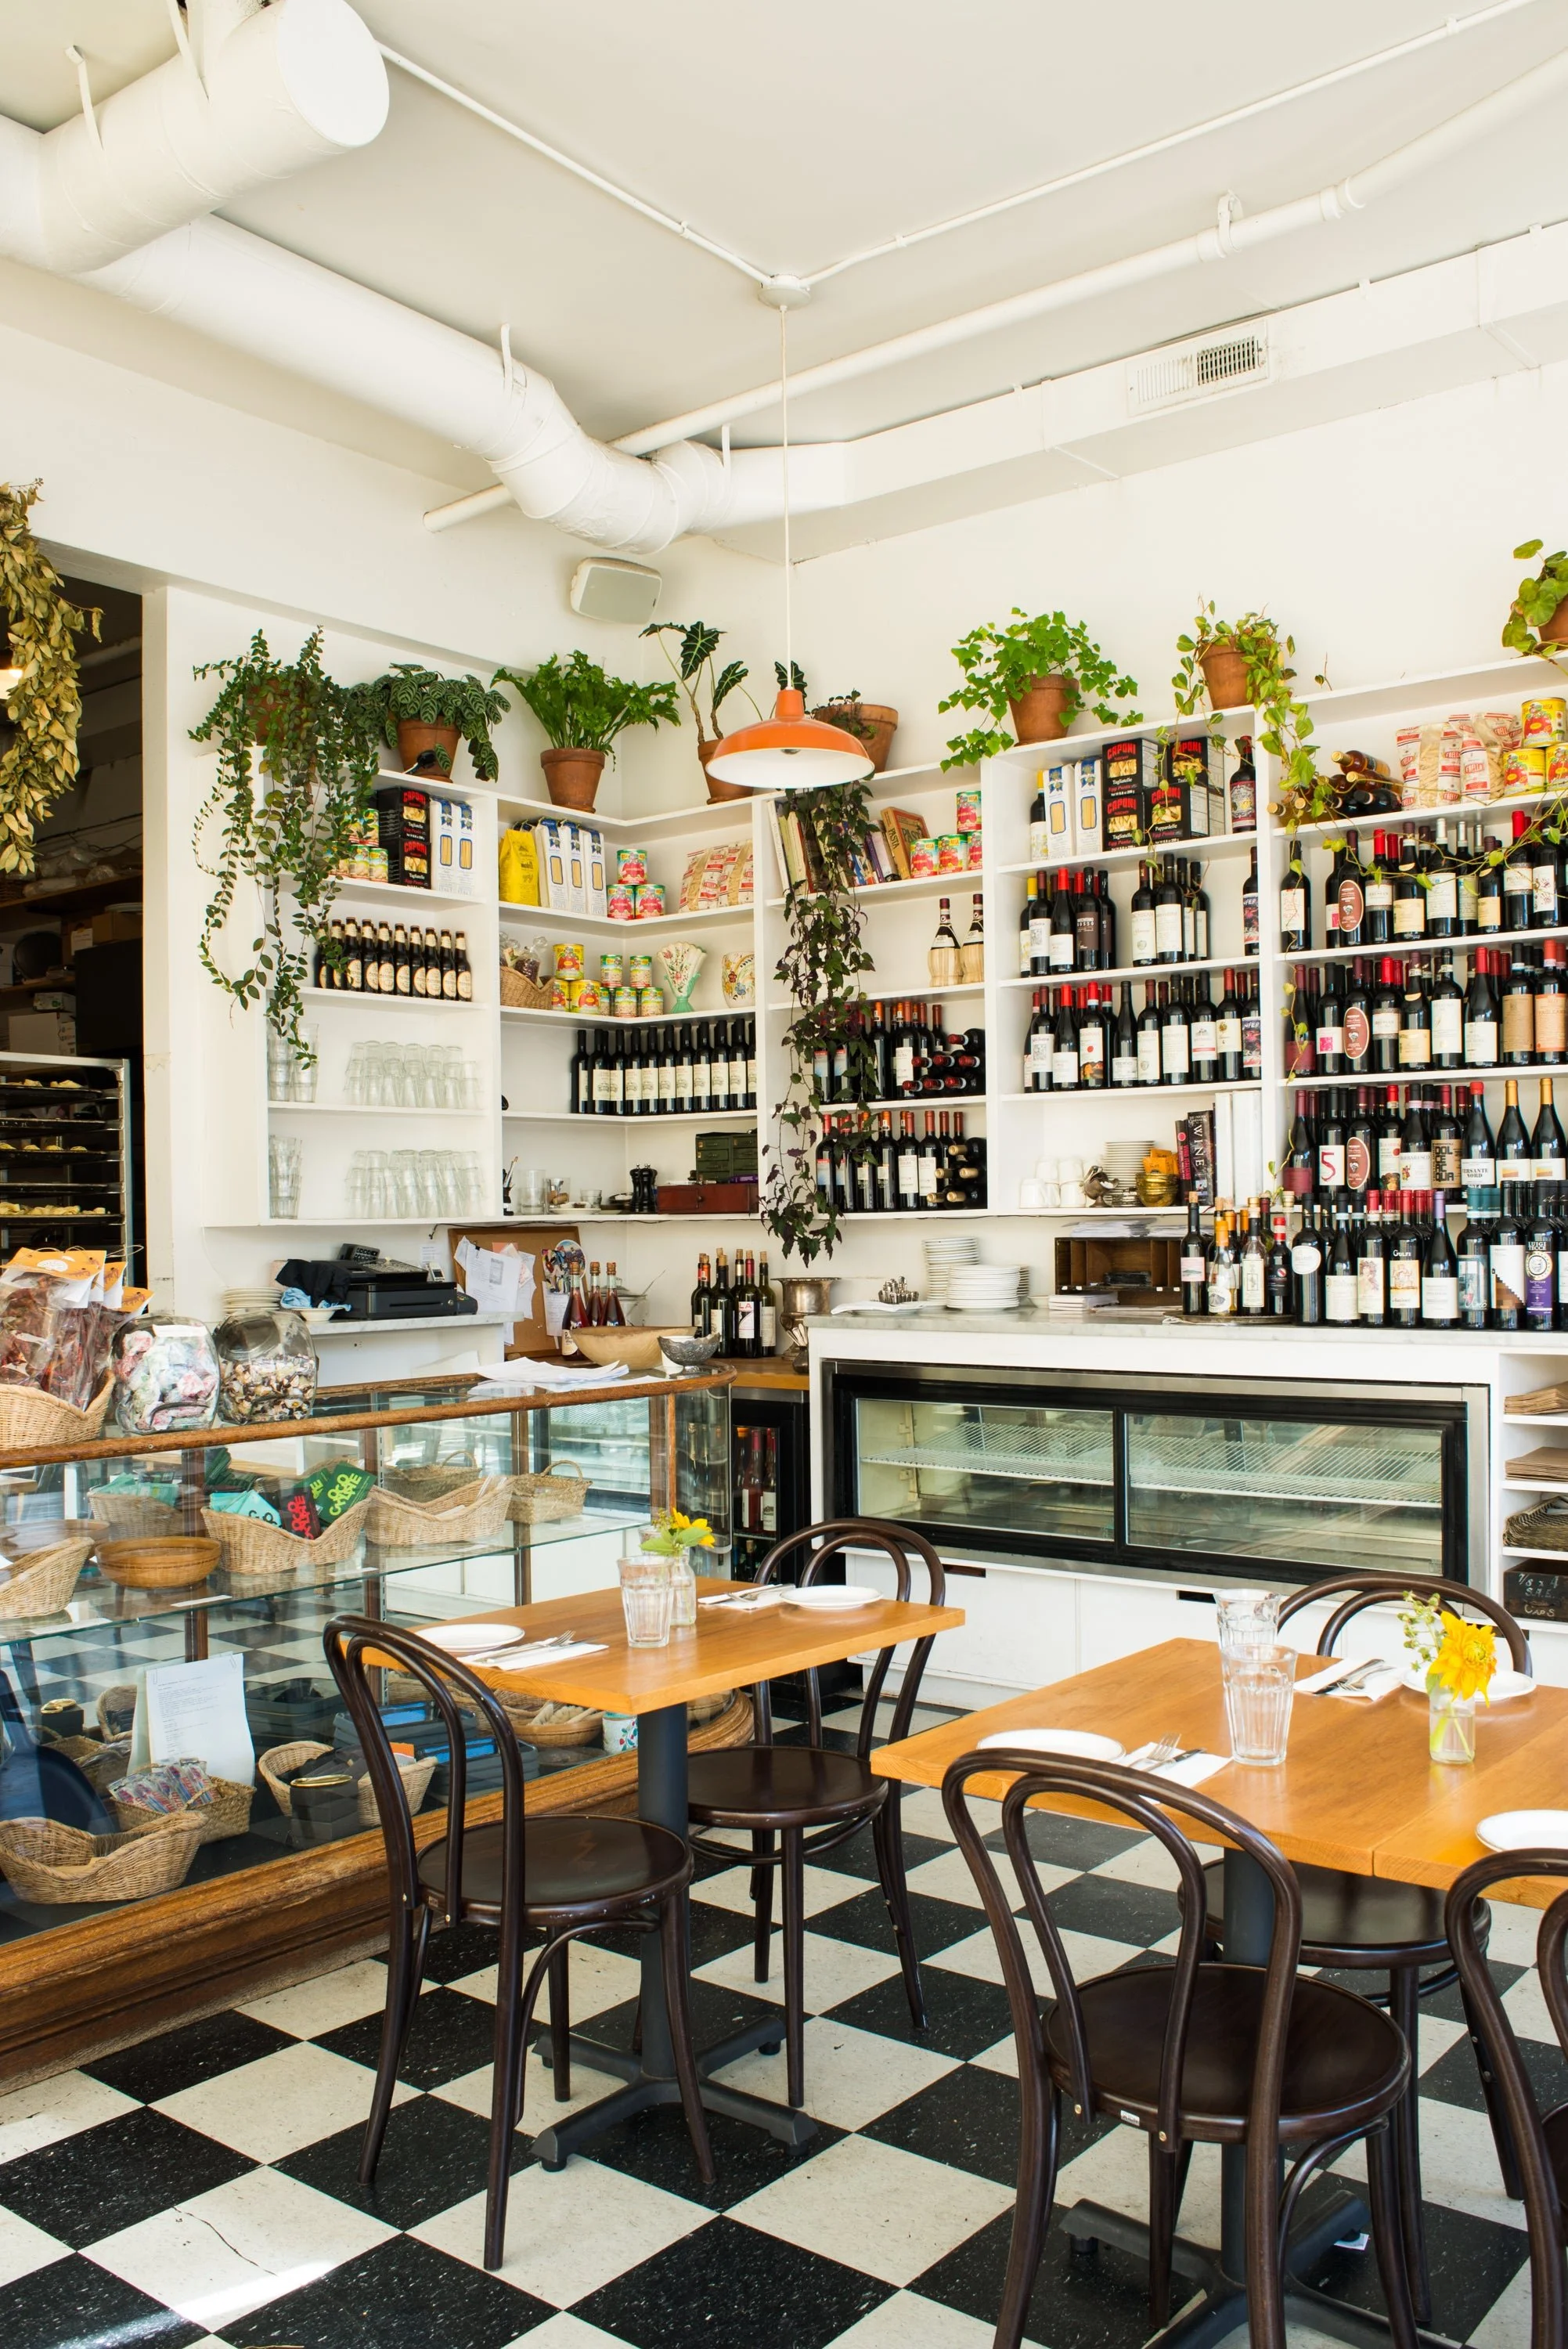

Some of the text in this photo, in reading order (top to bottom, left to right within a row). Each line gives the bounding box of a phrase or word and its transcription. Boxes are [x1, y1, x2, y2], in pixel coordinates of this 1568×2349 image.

[1107, 742, 1137, 760] CAPONI
[1107, 797, 1137, 814] CAPONI
[889, 828, 899, 848] PASTA
[1194, 1124, 1205, 1167] WINE
[1321, 1151, 1336, 1182] 5
[1435, 1172, 1454, 1182] QUA
